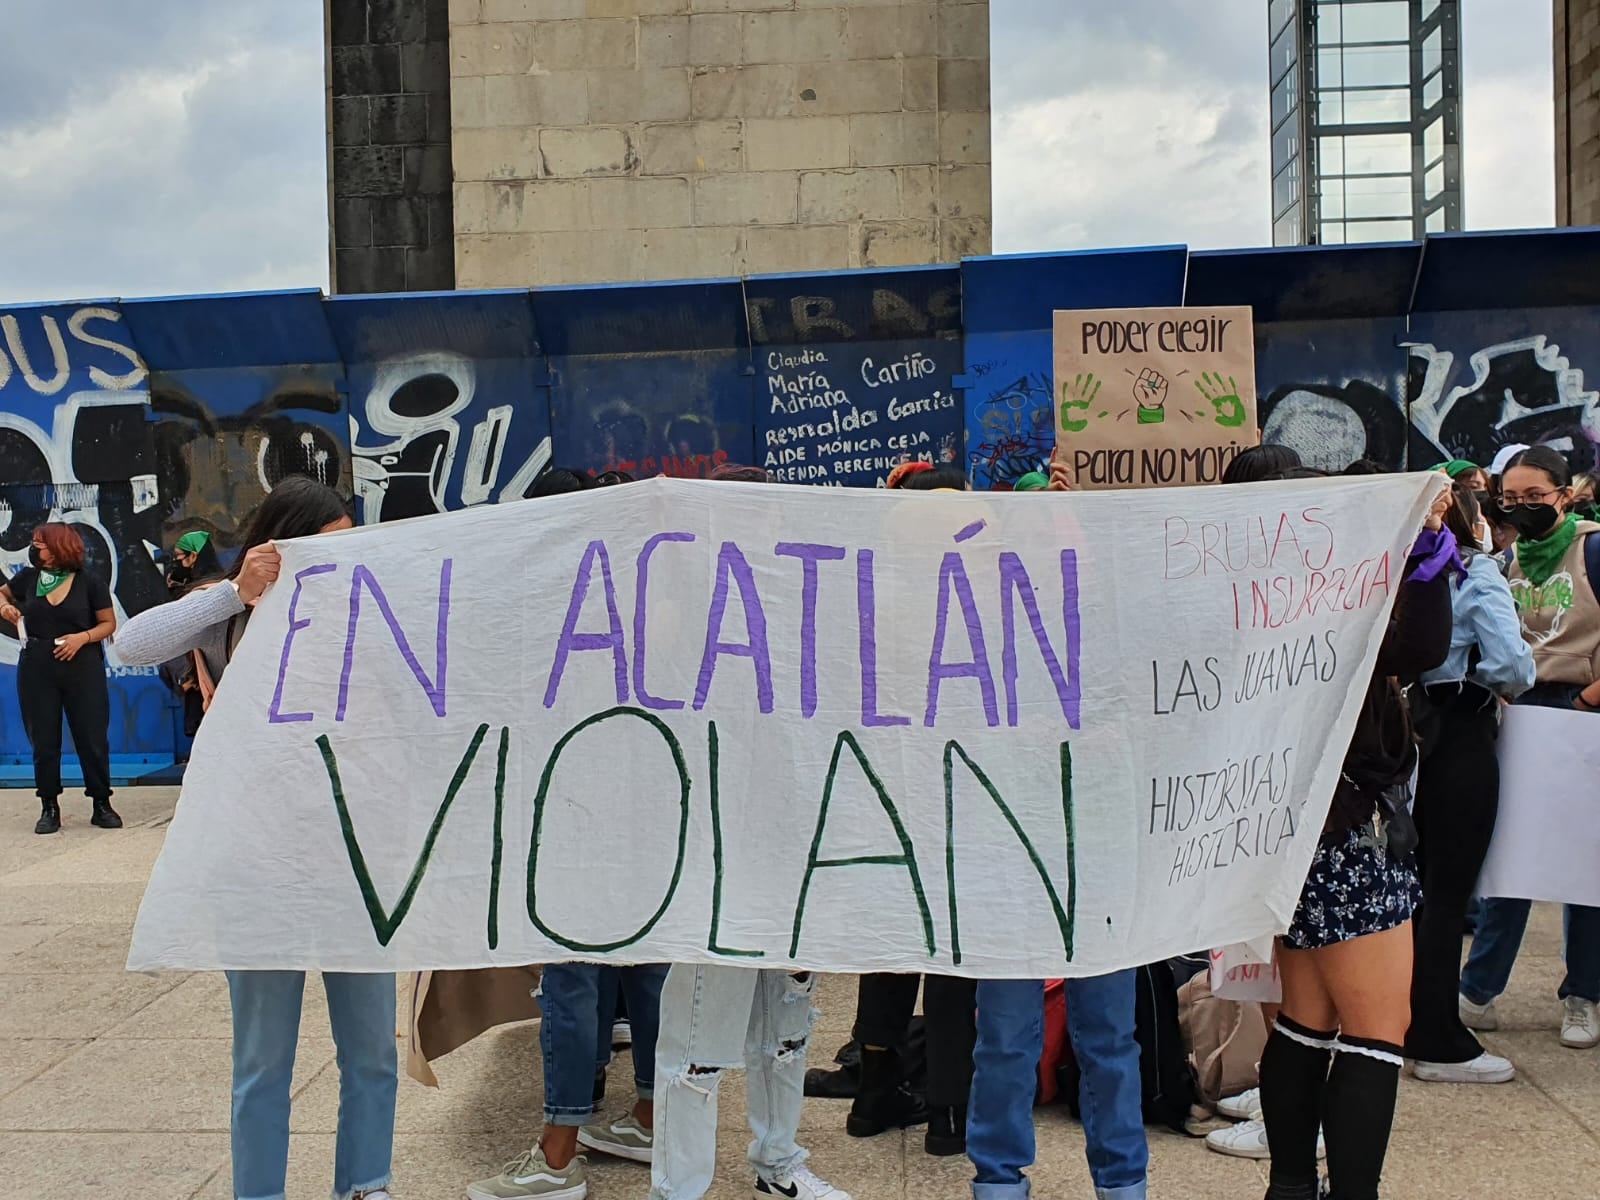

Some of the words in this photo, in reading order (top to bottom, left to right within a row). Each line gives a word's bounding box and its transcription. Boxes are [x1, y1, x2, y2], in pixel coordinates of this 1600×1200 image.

[0, 306, 149, 395] US
[1158, 315, 1232, 353] elegir
[767, 350, 829, 371] Claudia
[861, 352, 936, 388] Cariño
[768, 371, 830, 394] María
[770, 389, 851, 414] Adriana
[764, 446, 806, 467] AIDE
[888, 431, 930, 449] CEJA
[1141, 448, 1176, 484] NO
[1163, 507, 1335, 579] BRUJAS
[1232, 543, 1411, 630] INSURRECTA
[268, 557, 453, 723] EN
[543, 518, 1081, 730] ACATLÁN
[1152, 656, 1222, 715] LAS
[1234, 630, 1338, 704] JUANAS
[1168, 800, 1307, 887] HISTERICA
